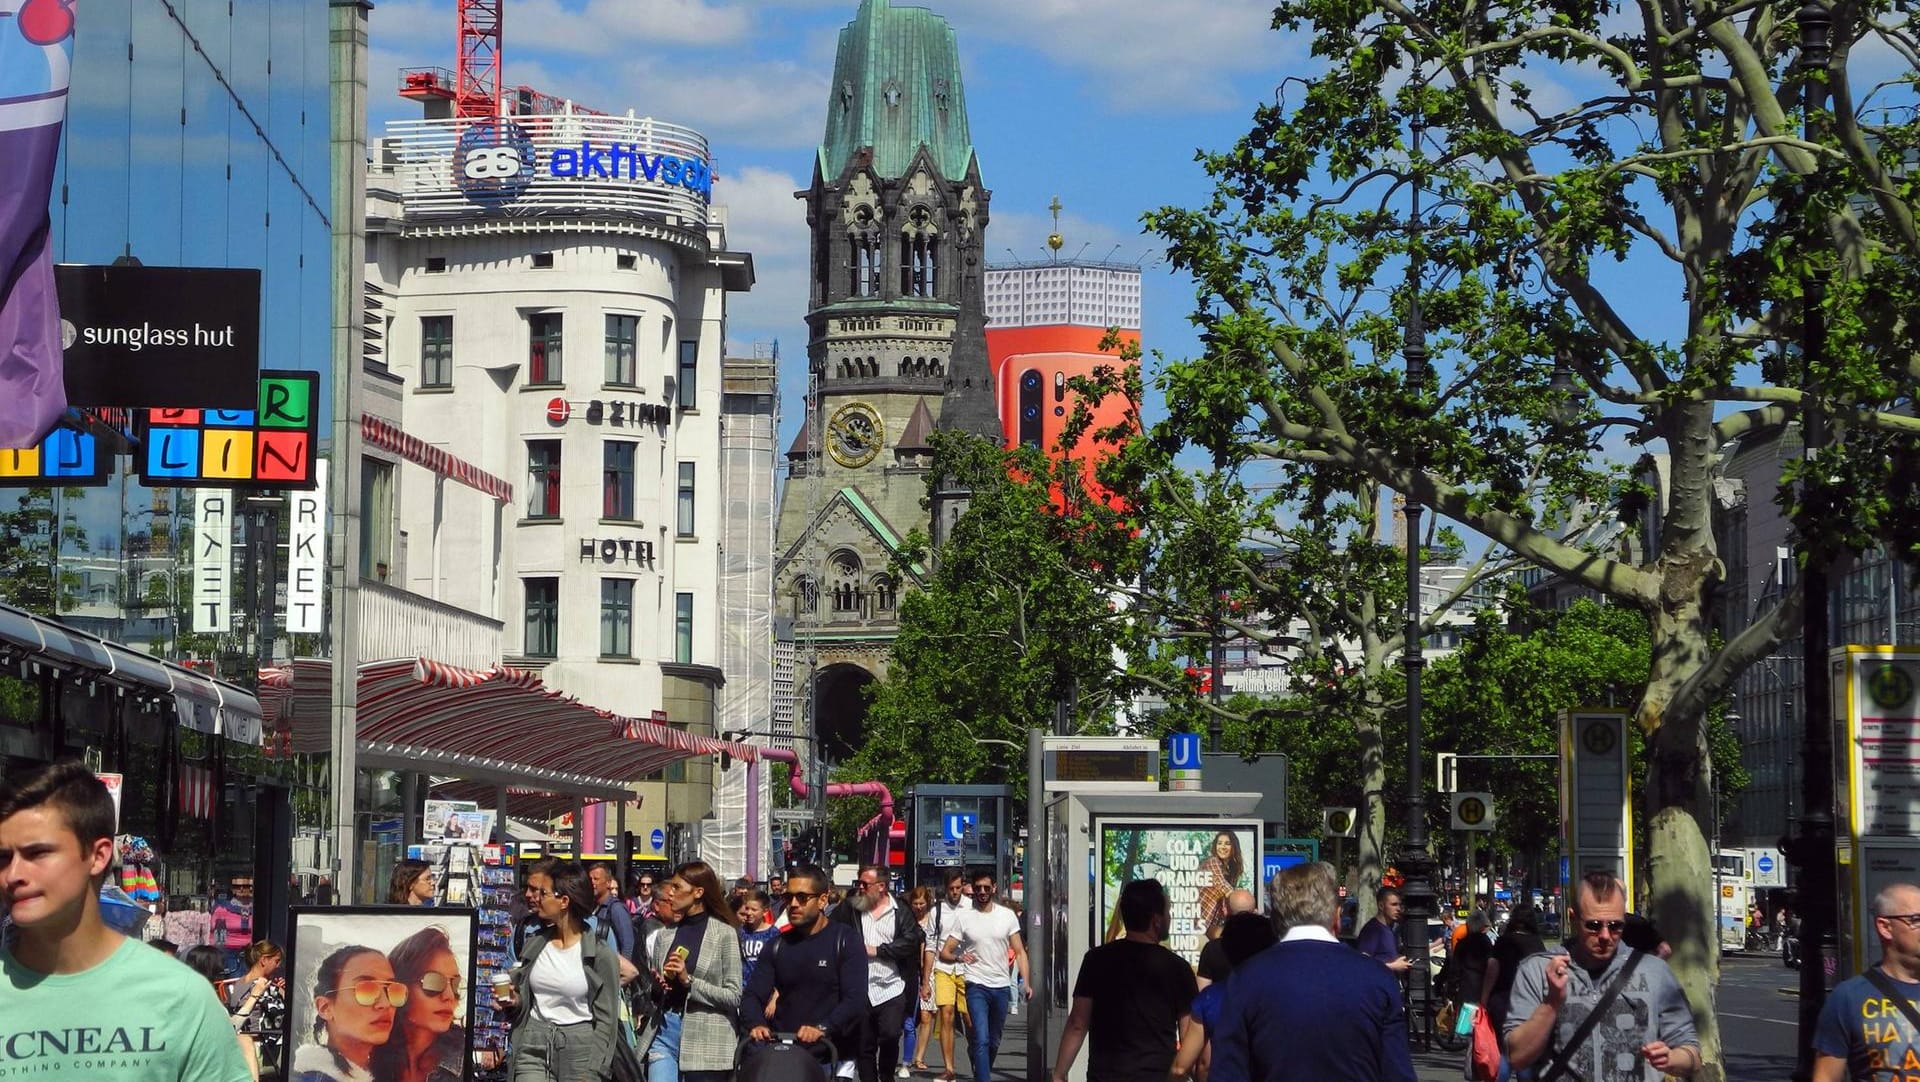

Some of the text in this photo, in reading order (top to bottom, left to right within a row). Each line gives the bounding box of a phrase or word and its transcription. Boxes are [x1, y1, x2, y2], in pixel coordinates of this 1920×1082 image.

[83, 322, 235, 351] sunglass hut
[580, 538, 656, 570] HOTEL
[1166, 839, 1203, 855] COLA
[1170, 855, 1200, 871] UND
[1155, 871, 1214, 887] ORANGE
[1170, 887, 1200, 903] UND
[1170, 935, 1199, 951] UND
[73, 1058, 151, 1070] COMPANY
